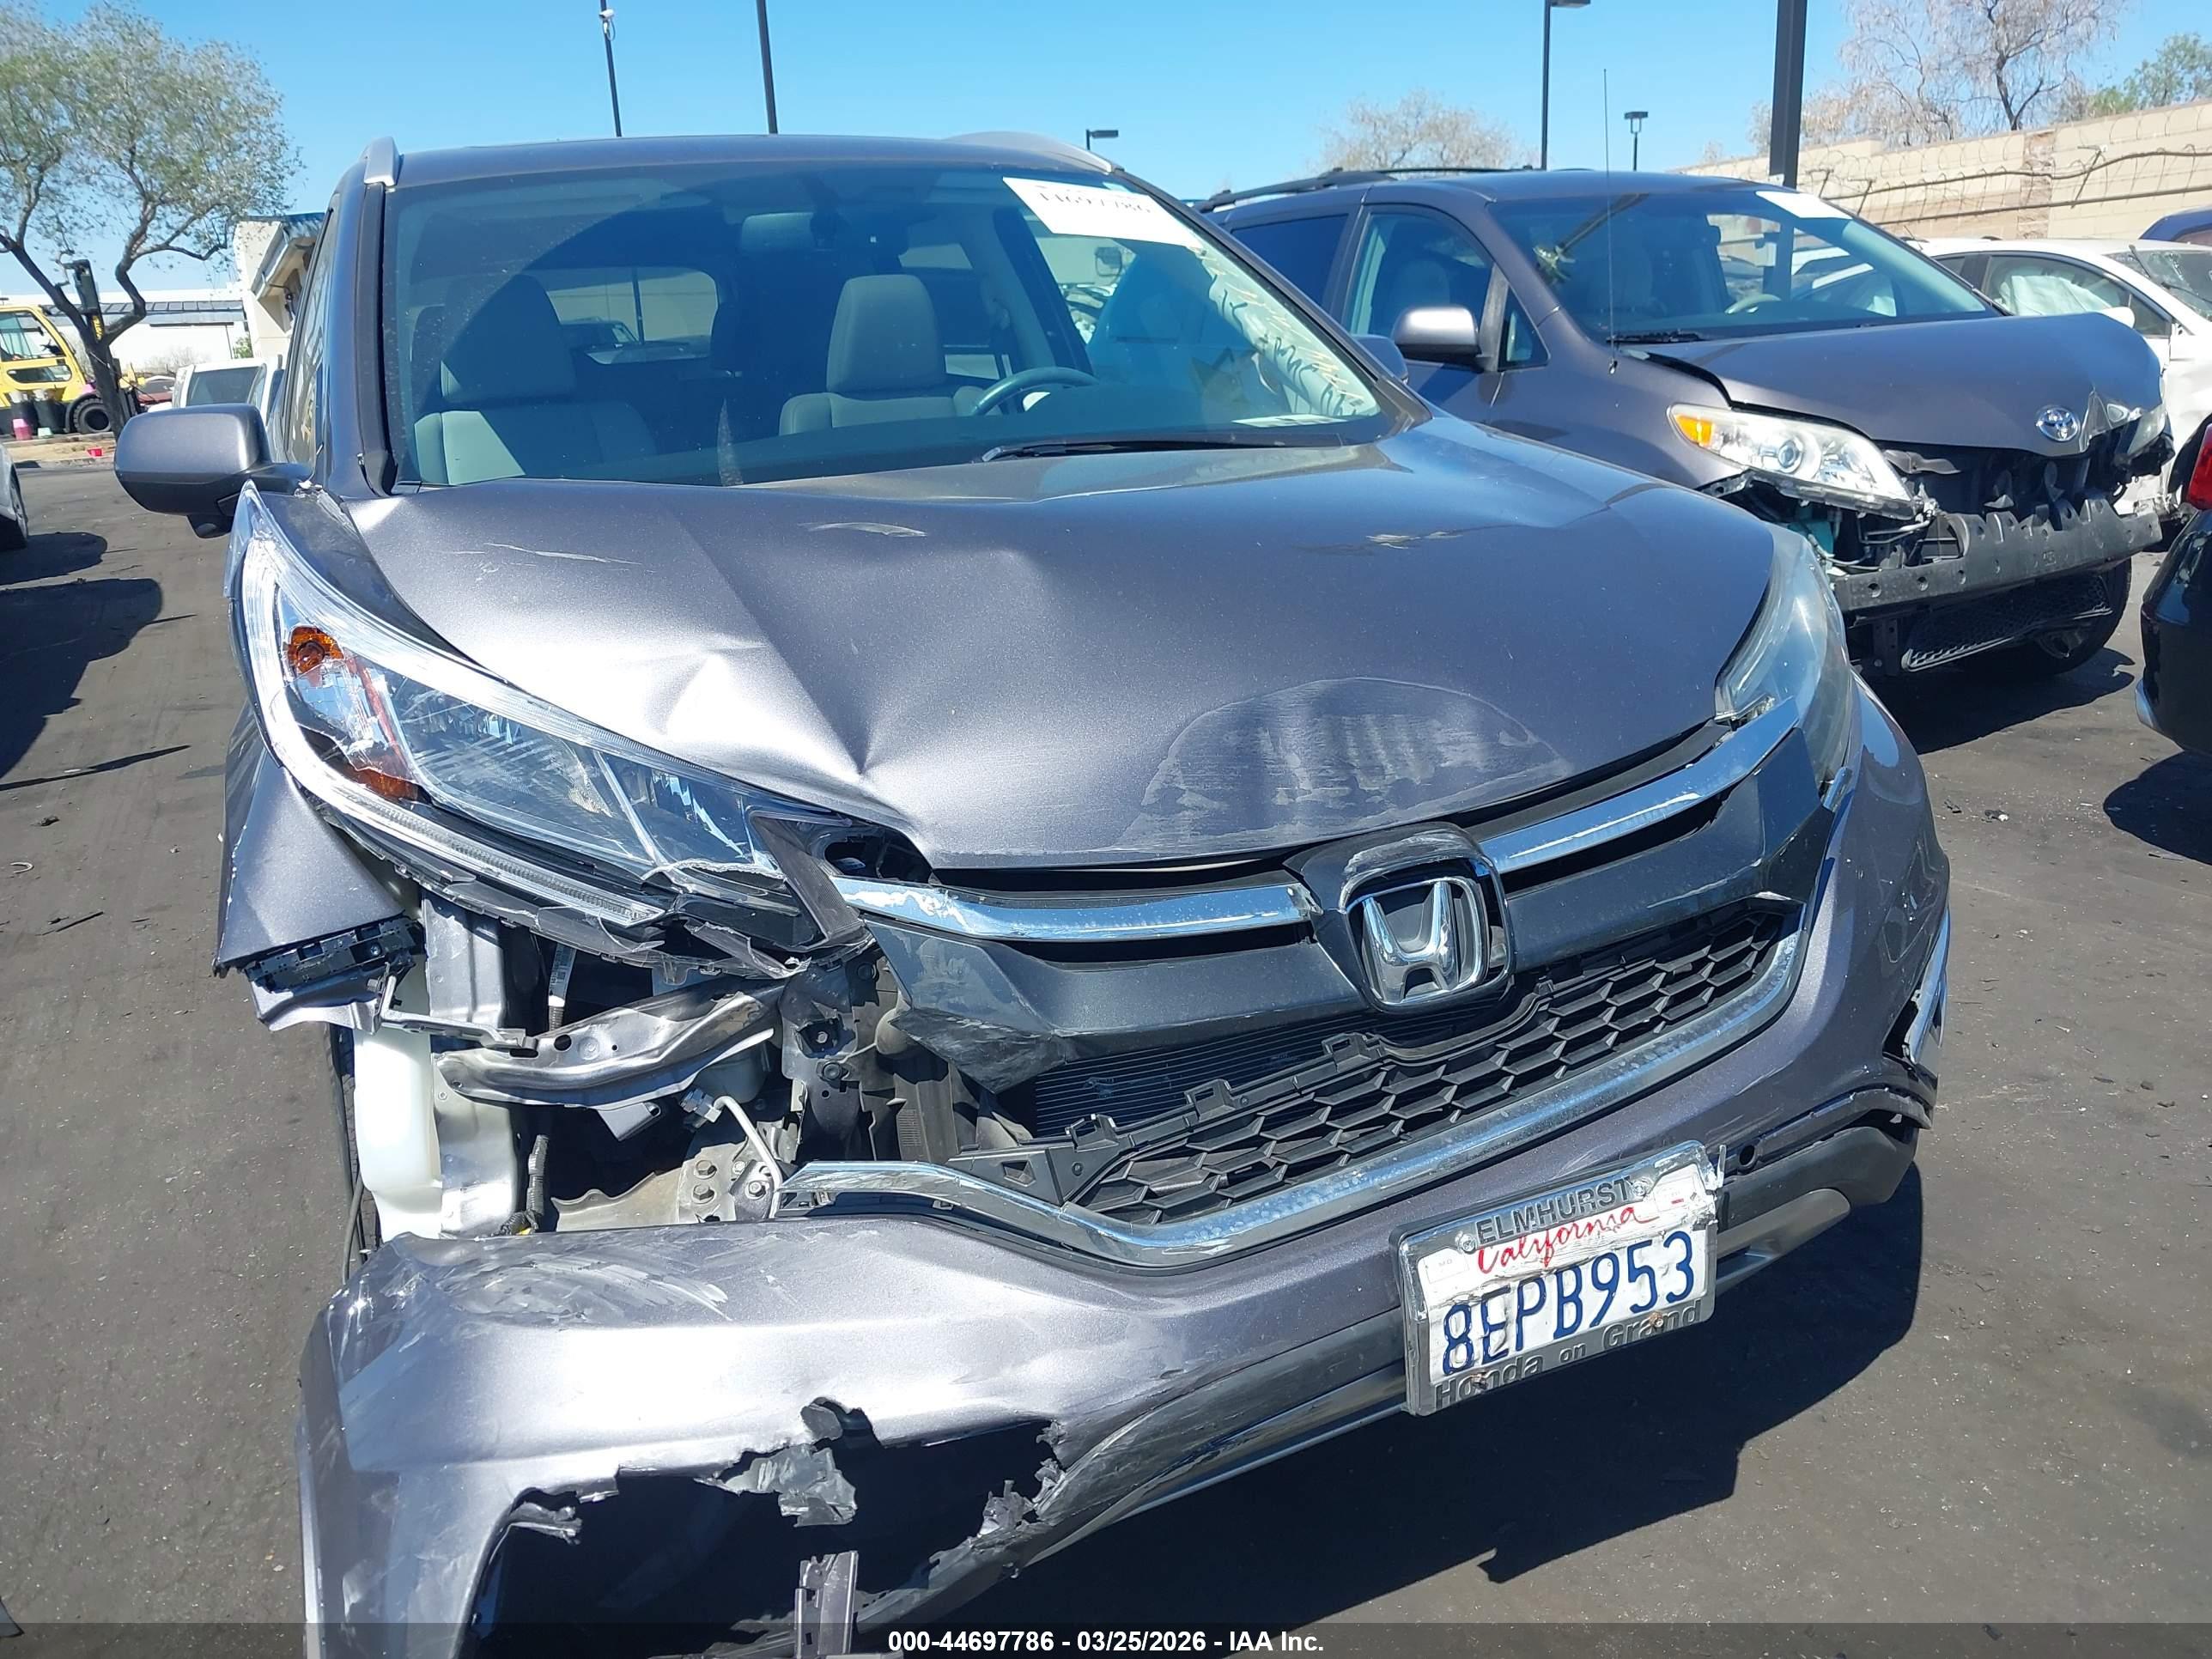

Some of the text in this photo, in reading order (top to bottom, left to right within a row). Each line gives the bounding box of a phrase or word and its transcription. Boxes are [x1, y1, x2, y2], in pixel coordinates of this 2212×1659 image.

[1474, 1174, 1632, 1245] ELMHURST
[1477, 1206, 1660, 1274] California
[1442, 1230, 1695, 1376] 8EPB953
[1434, 1298, 1702, 1410] Honda on Grand
